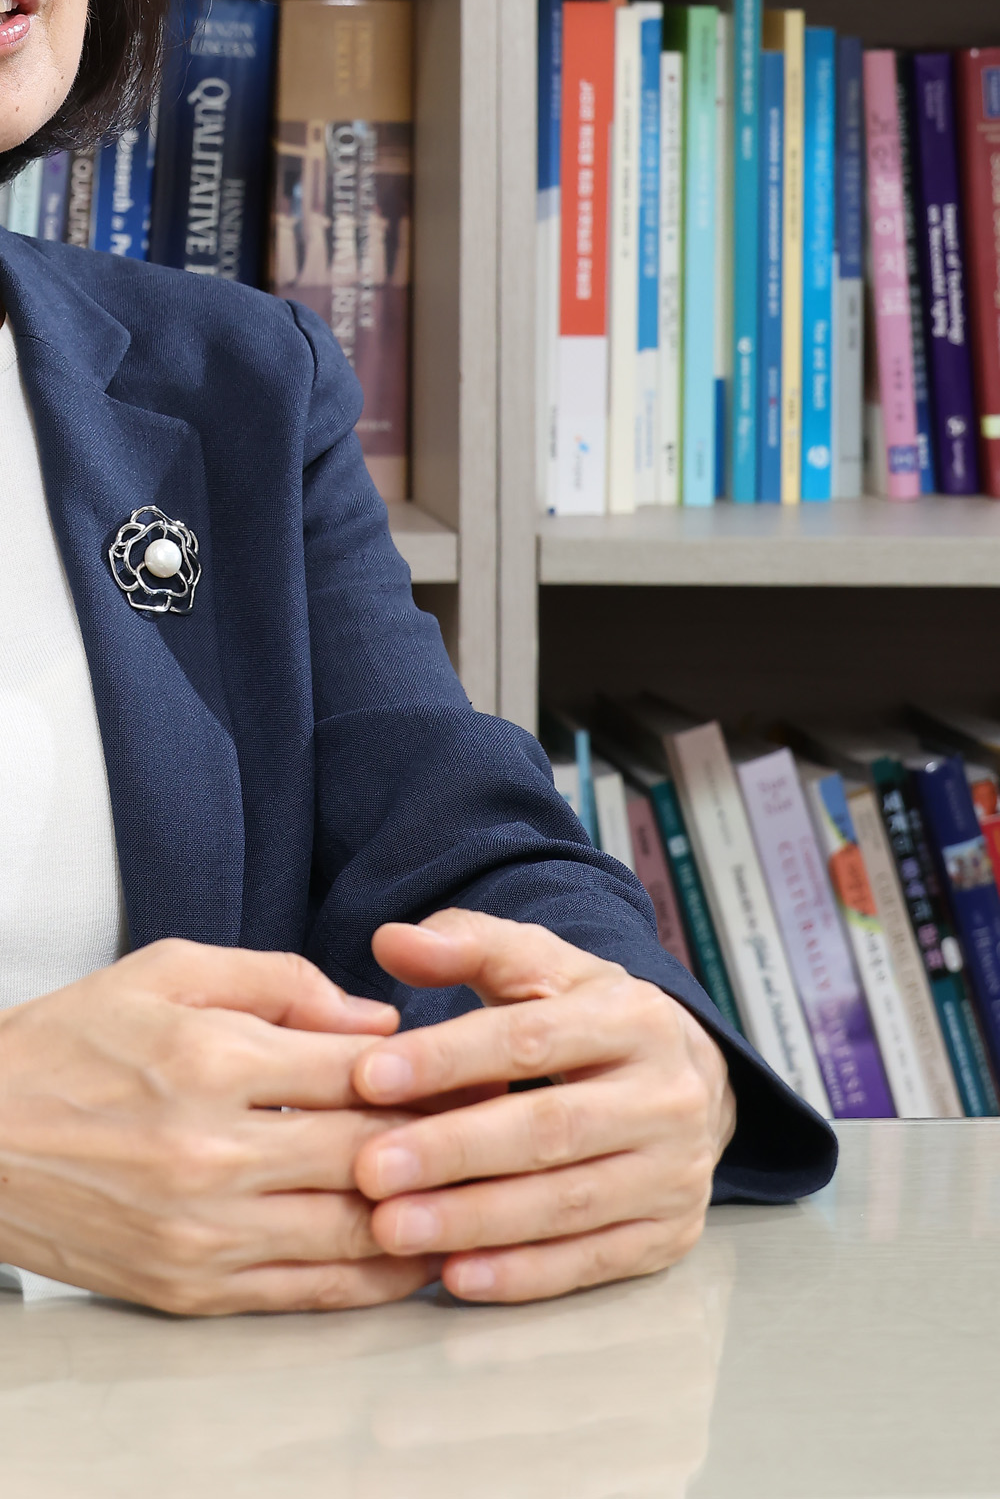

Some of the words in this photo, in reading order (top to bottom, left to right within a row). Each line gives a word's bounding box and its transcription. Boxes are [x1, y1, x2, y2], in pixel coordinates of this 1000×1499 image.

[185, 76, 232, 256] QUALITATIVE
[331, 124, 362, 280] QUALITATIVE
[220, 178, 246, 282] HANDBOO
[331, 286, 357, 366] RESEA
[946, 269, 965, 347] Technology
[818, 1000, 867, 1105] DIVERSE
